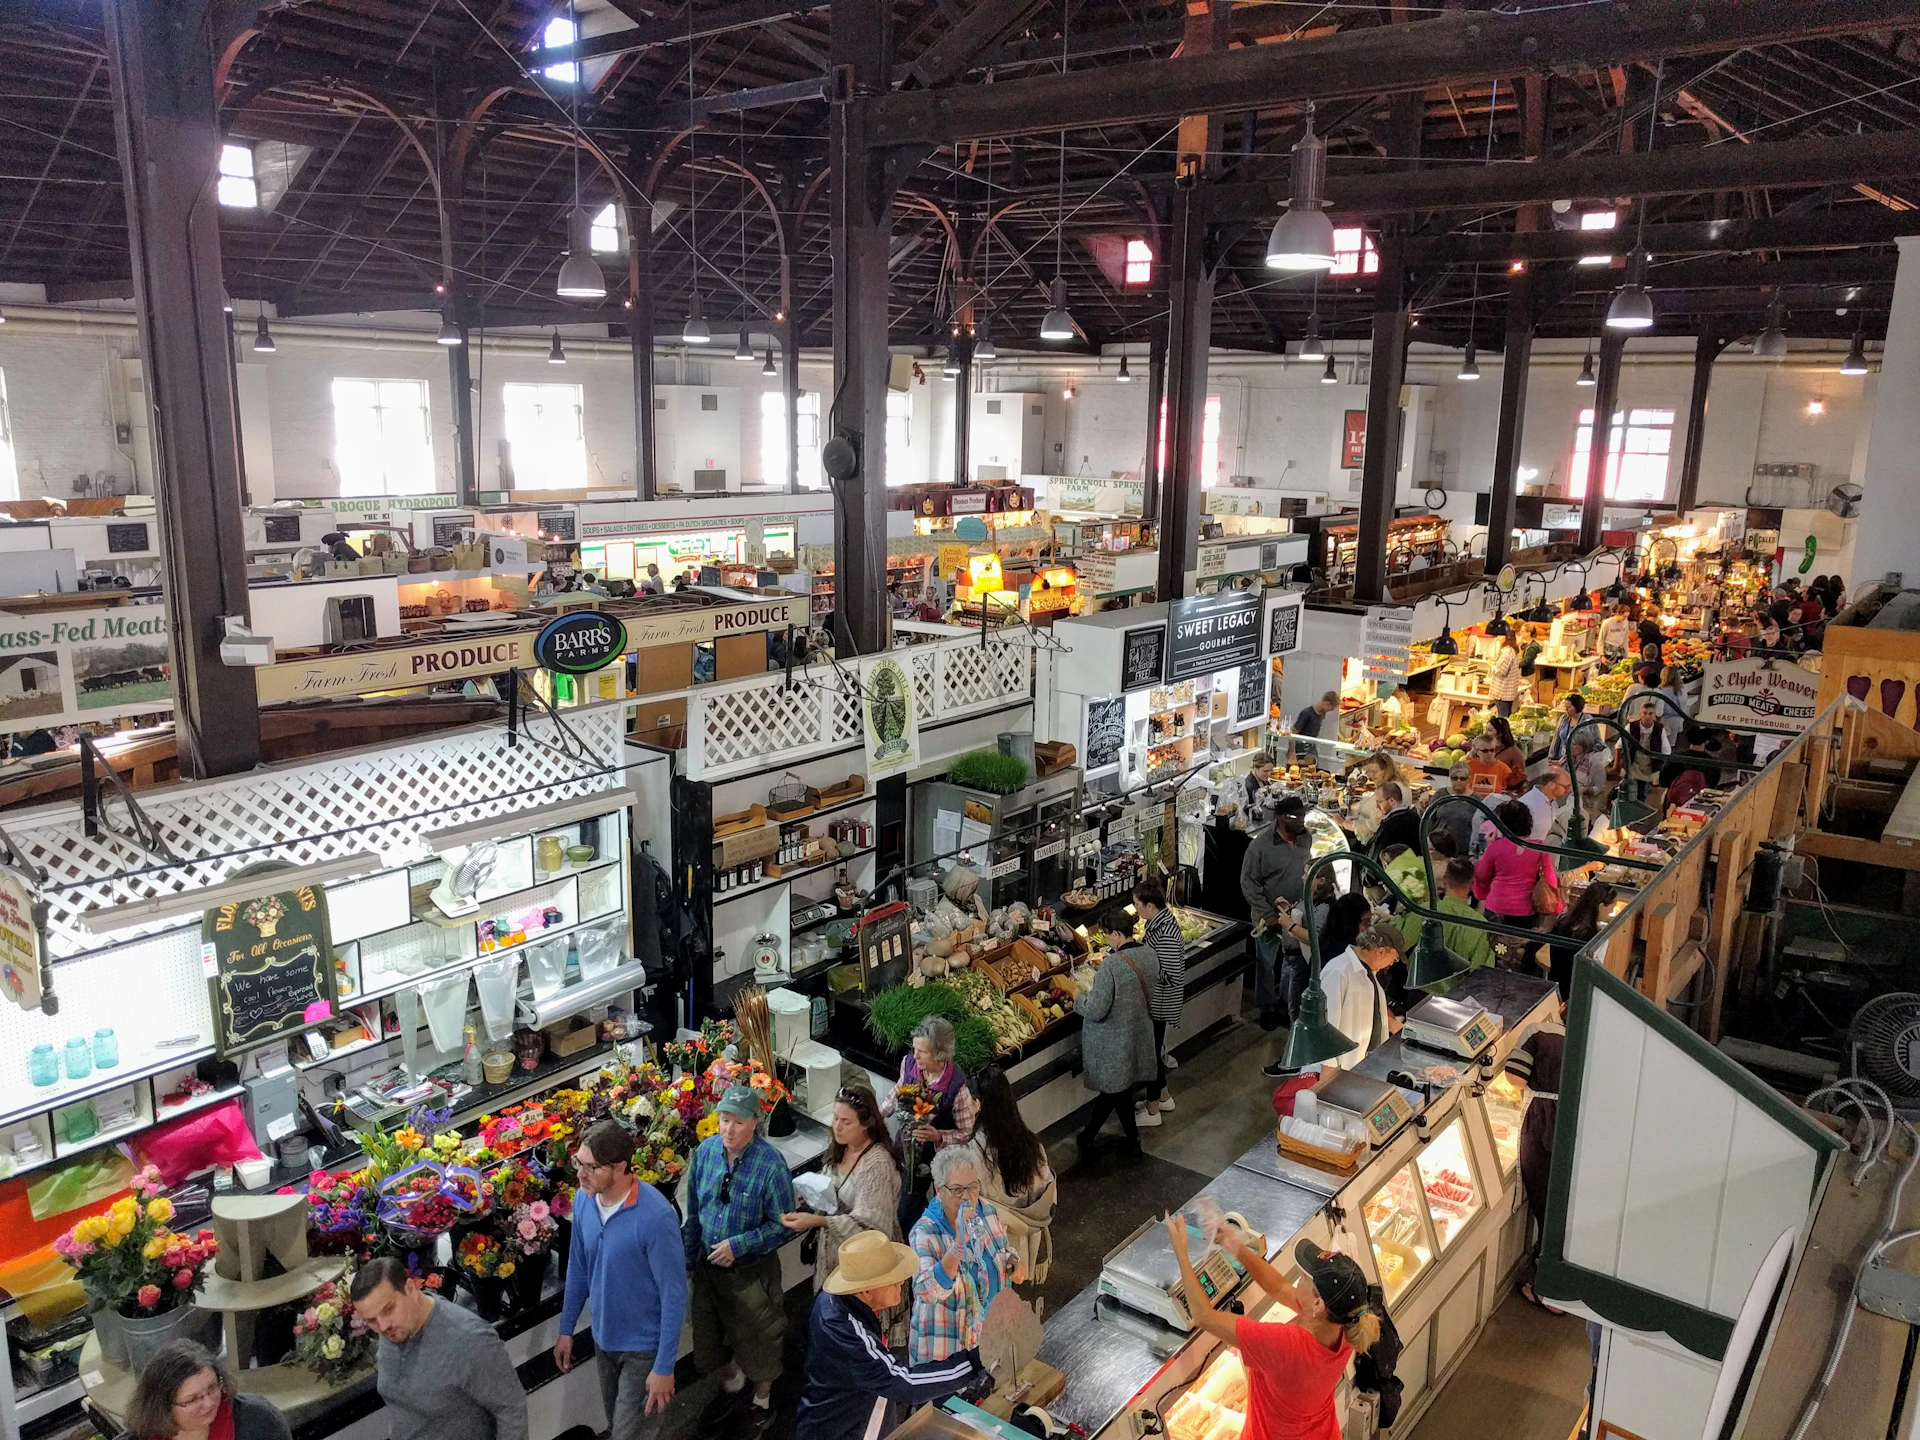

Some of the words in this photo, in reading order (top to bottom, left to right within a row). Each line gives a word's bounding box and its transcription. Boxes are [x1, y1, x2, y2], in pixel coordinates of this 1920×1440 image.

[1049, 477, 1079, 485] SPRING
[1066, 484, 1089, 492] FARM
[331, 500, 380, 512] BROGUE
[387, 496, 457, 509] HYDROPONI
[969, 496, 985, 504] Produce
[582, 526, 600, 535] SOUPS
[603, 524, 623, 533] SALADS
[626, 523, 648, 532] ENTREES
[651, 521, 676, 530] DESSERTS
[685, 520, 701, 528] DUTCH
[701, 519, 728, 527] SPECIALTIES
[943, 548, 963, 556] Amish
[1202, 552, 1227, 562] VEGETABLES
[1274, 608, 1297, 622] COOKIES
[635, 624, 671, 642] Farm
[673, 619, 705, 637] Fresh
[715, 606, 789, 631] PRODUCE
[1177, 618, 1214, 640] SWEET
[1217, 610, 1257, 631] LEGACY
[1273, 618, 1296, 635] MAKE
[1368, 621, 1393, 629] VINTAGE
[553, 620, 612, 651] BARR'S
[1367, 634, 1392, 642] CARAMEL
[1199, 635, 1235, 651] GOURMET
[1380, 648, 1405, 656] BRITTLES
[294, 669, 346, 691] Farm
[350, 661, 398, 683] Fresh
[411, 642, 520, 675] PRODUCE
[878, 660, 897, 670] TREE
[1371, 660, 1399, 668] COOKIES
[1364, 672, 1387, 680] CARAMEL
[1387, 674, 1407, 682] APPLES
[1713, 674, 1724, 689] S.
[1726, 671, 1763, 692] Clyde
[1767, 671, 1818, 700] Weaver
[1712, 694, 1745, 705] SMOKED
[1748, 697, 1775, 713] MEATS
[1783, 706, 1816, 718] CHEESE
[1717, 713, 1736, 722] EAST
[882, 742, 903, 754] FARM
[1178, 794, 1189, 805] SALAD
[1144, 806, 1160, 816] HERBS
[1111, 817, 1133, 832] SPROUTS
[1078, 831, 1093, 844] EGGS
[1116, 833, 1126, 841] TEA
[1036, 842, 1064, 859] TOMATOES
[991, 861, 1017, 877] PEPPERS
[226, 950, 246, 965] For
[251, 942, 269, 957] All
[272, 932, 313, 951] Occasions
[234, 979, 252, 992] We
[259, 973, 280, 984] have
[285, 965, 309, 977] some
[243, 992, 260, 1003] cool
[267, 985, 293, 998] flowers
[296, 991, 314, 1001] Love
